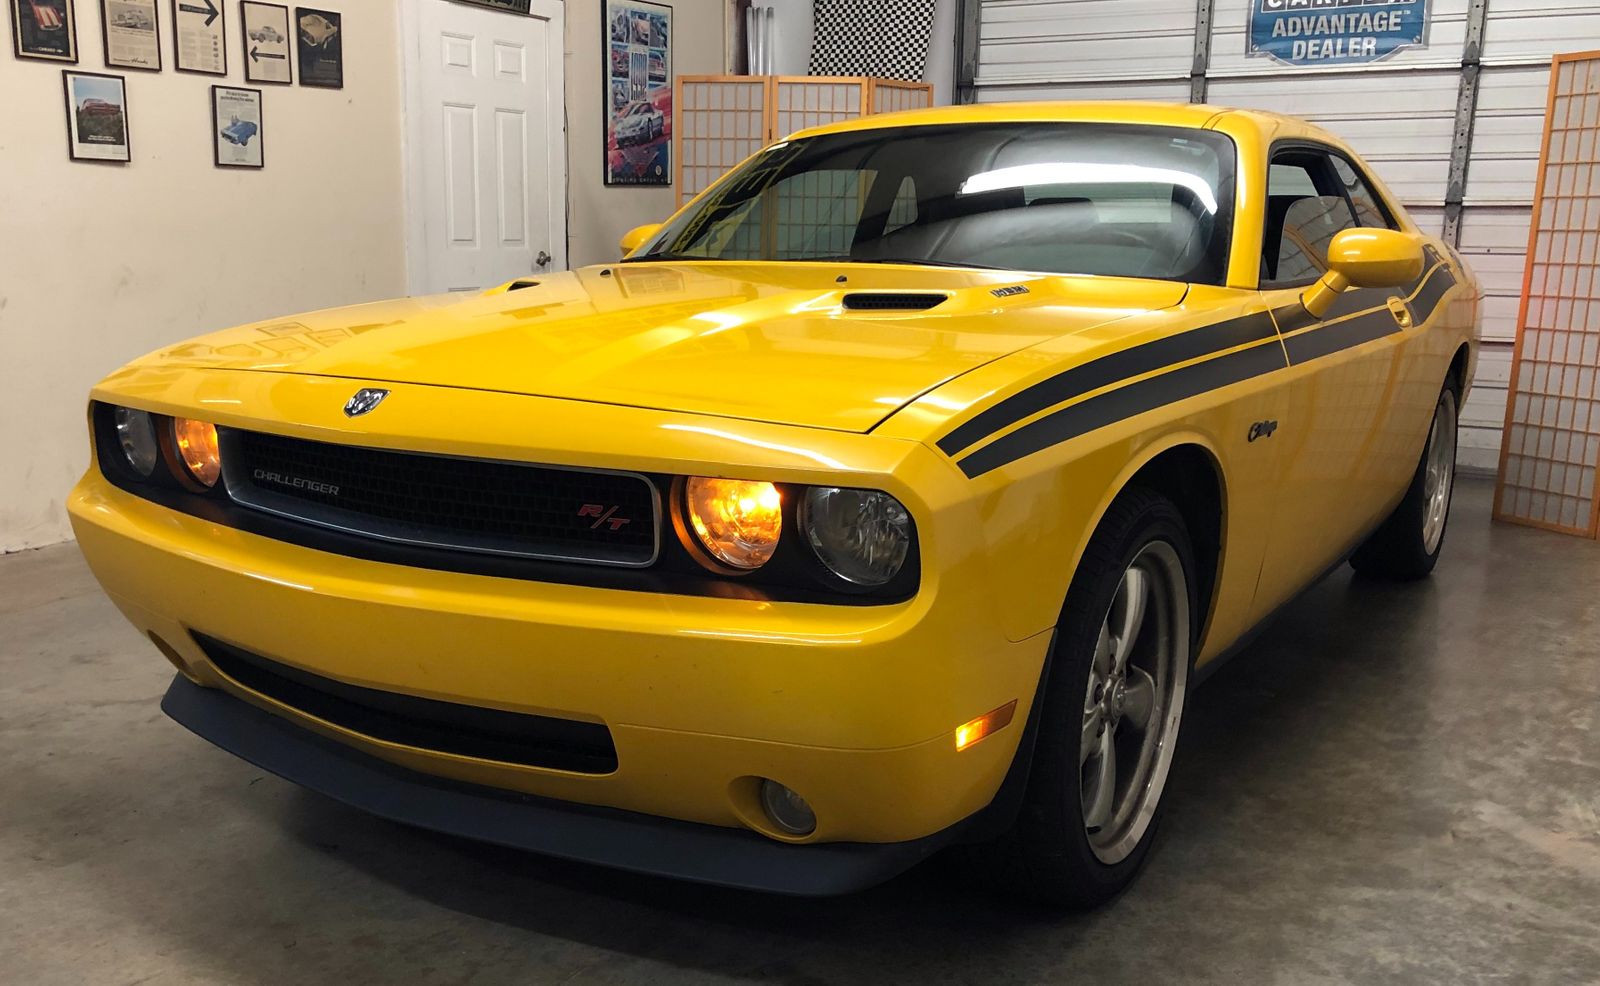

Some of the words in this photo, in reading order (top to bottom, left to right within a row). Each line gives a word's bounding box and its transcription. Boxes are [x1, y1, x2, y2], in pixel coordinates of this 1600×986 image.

[1272, 10, 1402, 37] ADVANTAGE
[1292, 37, 1377, 60] DEALER
[253, 469, 340, 496] CHALLENGER
[576, 504, 631, 530] R/T
